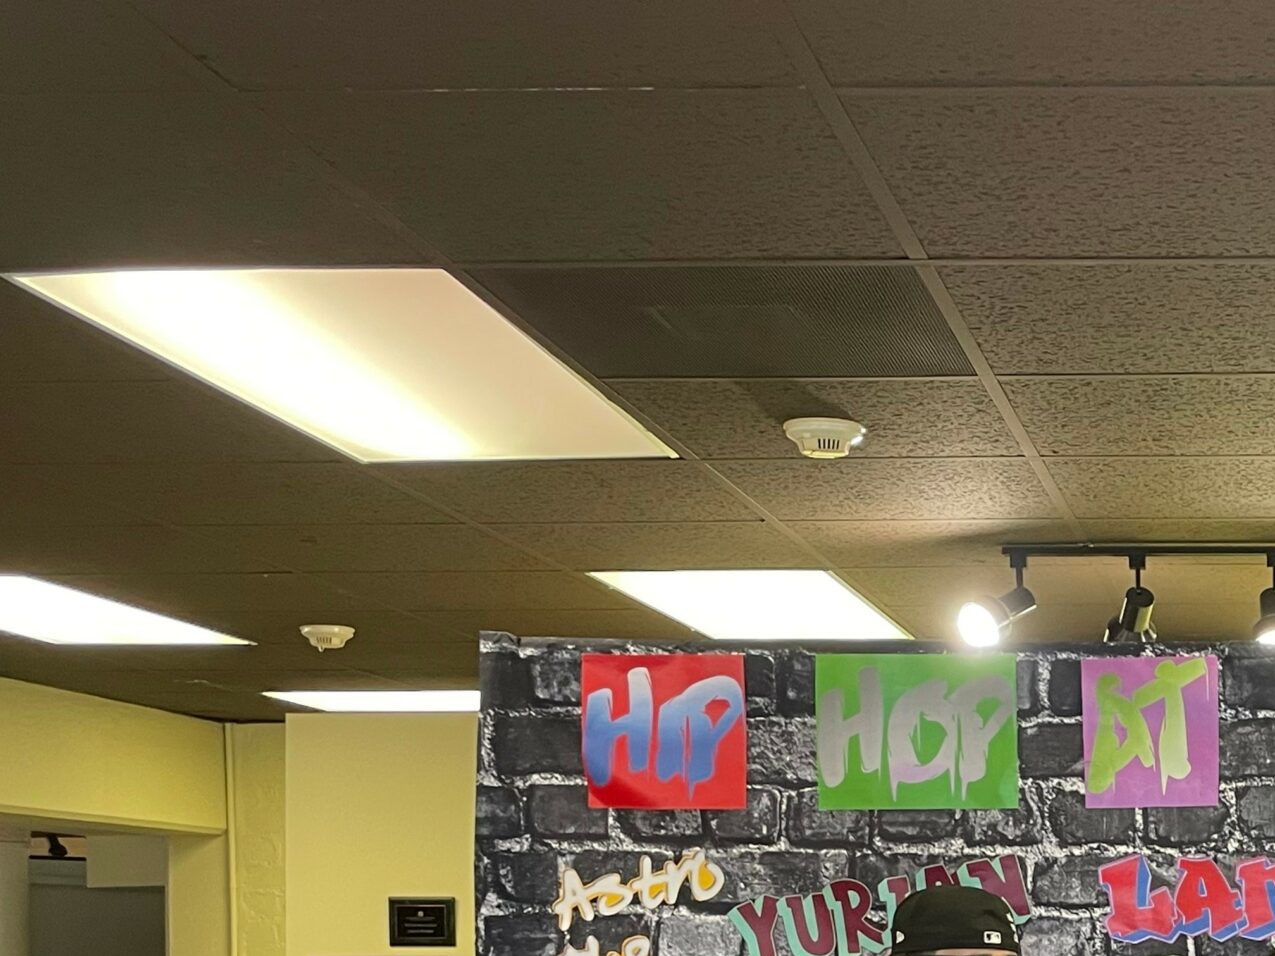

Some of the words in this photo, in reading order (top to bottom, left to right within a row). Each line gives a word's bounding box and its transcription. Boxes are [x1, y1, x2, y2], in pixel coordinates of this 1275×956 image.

[584, 667, 743, 801] HIP
[817, 666, 1013, 801] HOP
[1085, 656, 1208, 797] AT
[552, 847, 724, 931] Astro
